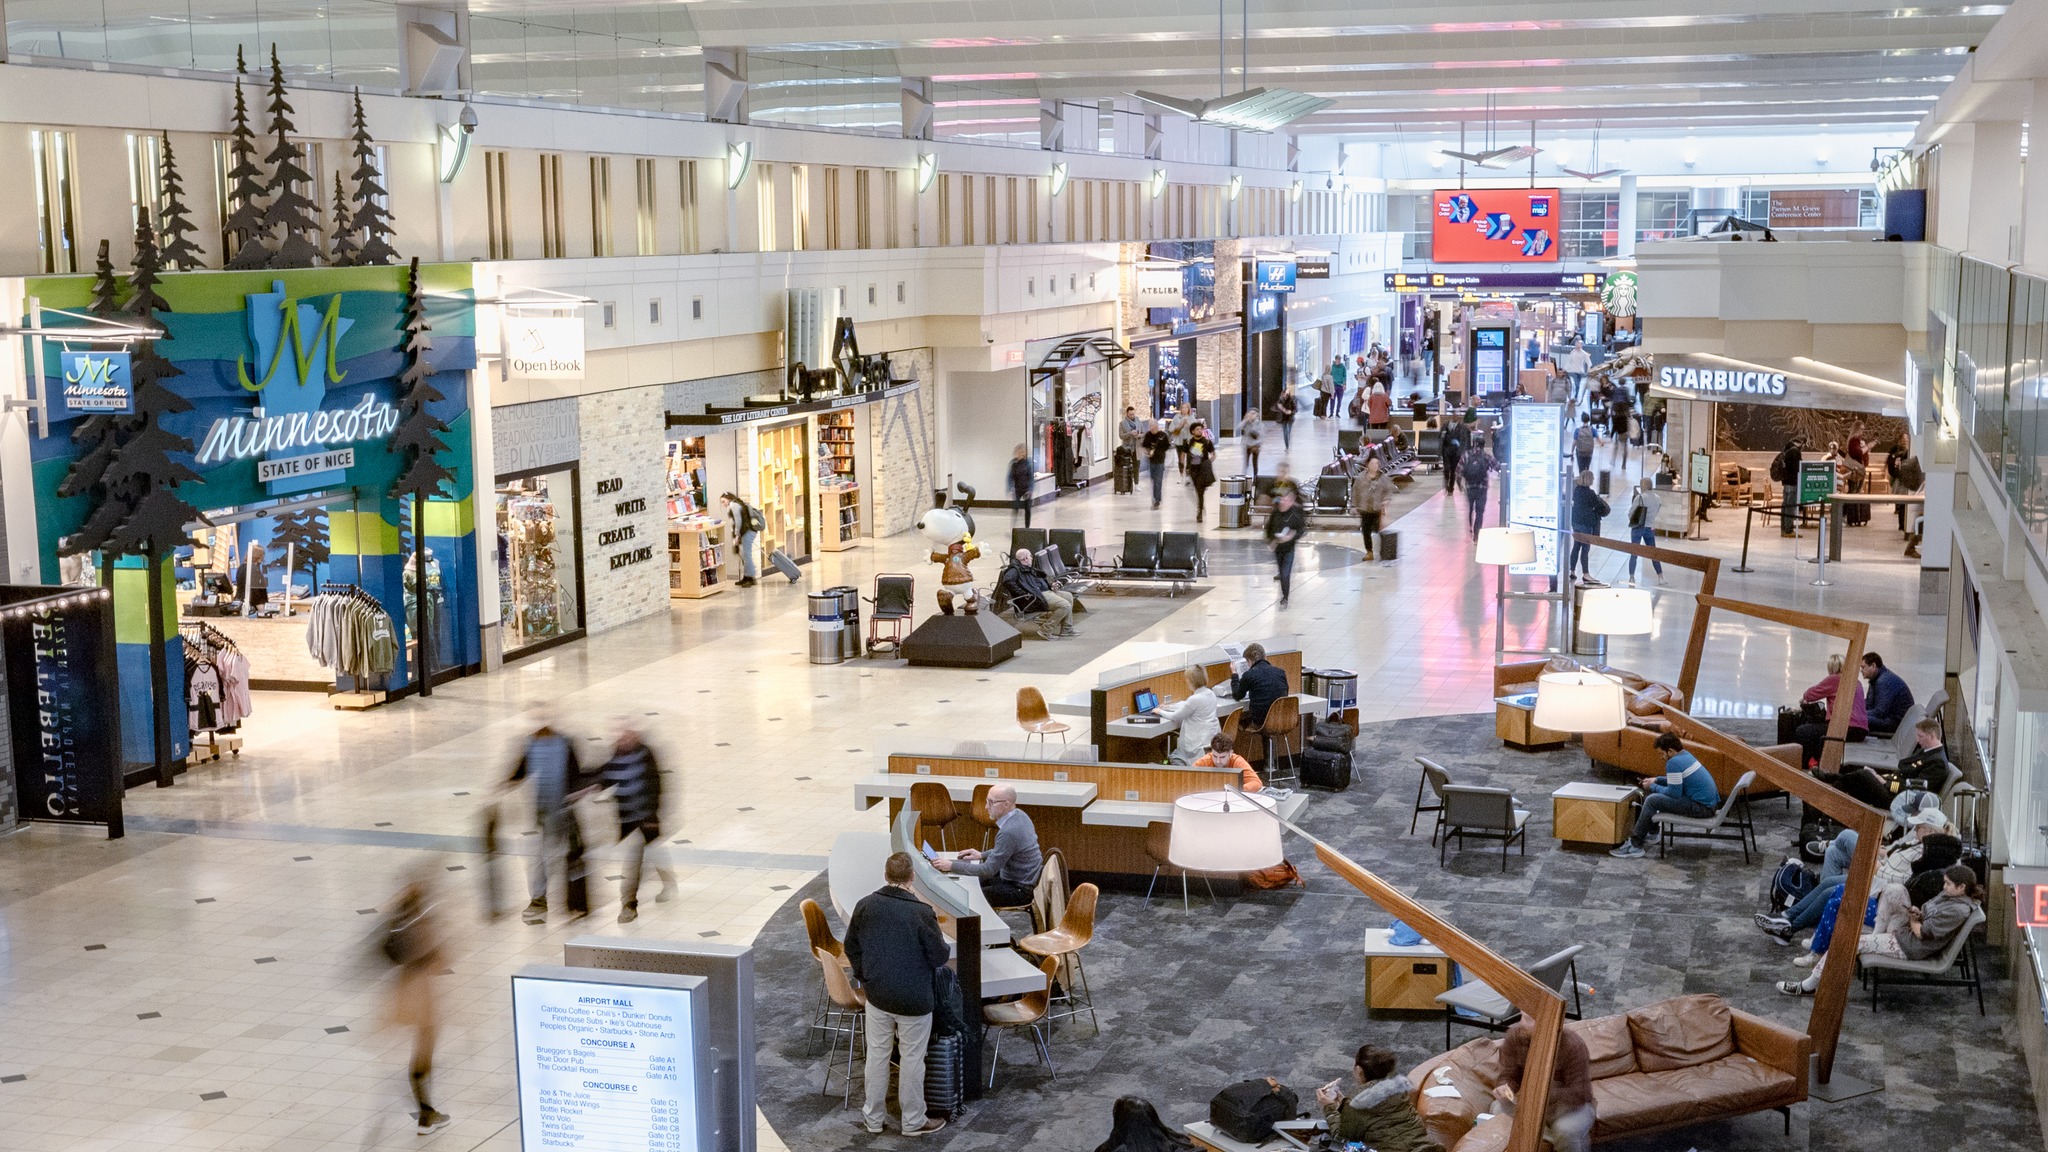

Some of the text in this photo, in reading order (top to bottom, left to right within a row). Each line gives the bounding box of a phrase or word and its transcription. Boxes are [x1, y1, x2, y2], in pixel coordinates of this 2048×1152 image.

[1260, 282, 1294, 291] Hudson
[1445, 276, 1465, 286] Baggage
[1466, 276, 1480, 284] Claim
[238, 293, 347, 391] M
[514, 359, 580, 374] Open Book
[1660, 366, 1786, 395] STARBUCKS
[64, 385, 128, 397] Minnesota
[497, 403, 536, 423] SCHOOL
[721, 414, 732, 424] THE
[733, 412, 746, 422] LOFT
[195, 392, 399, 464] Minnesota
[497, 428, 536, 448] READING
[263, 452, 352, 478] STATE OF NICE
[510, 443, 544, 472] PLAY
[597, 478, 623, 496] READ
[615, 498, 646, 516] WRITE
[598, 524, 636, 546] CREATE
[610, 546, 652, 570] EXPLORE
[578, 996, 634, 1008] AIRPORT MALL
[541, 1005, 567, 1014] Caribou
[568, 1007, 590, 1016] Coffee
[648, 1014, 672, 1022] Donuts
[552, 1014, 584, 1024] Firehouse
[586, 1017, 604, 1025] Subs
[626, 1020, 662, 1029] Clubhouse
[540, 1022, 566, 1032] Peoples
[568, 1024, 594, 1034] Organic
[600, 1027, 632, 1036] Starbucks
[639, 1030, 658, 1038] Stone
[580, 1038, 628, 1048] CONCOURSE
[573, 1049, 596, 1058] Bagels
[649, 1055, 665, 1063] Gate
[552, 1064, 578, 1072] Cocktail
[571, 1057, 584, 1065] Pub
[649, 1064, 666, 1072] Gate
[583, 1081, 630, 1091] CONCOURSE
[540, 1097, 562, 1105] Buffalo
[580, 1101, 600, 1110] Wings
[650, 1098, 666, 1106] Gate
[540, 1105, 558, 1113] Bottle
[560, 1107, 582, 1115] Rocket
[651, 1115, 667, 1123] Gate
[541, 1122, 560, 1130] Twins
[542, 1130, 680, 1149] Smashburger Gate C12
[542, 1138, 574, 1148] Starbucks
